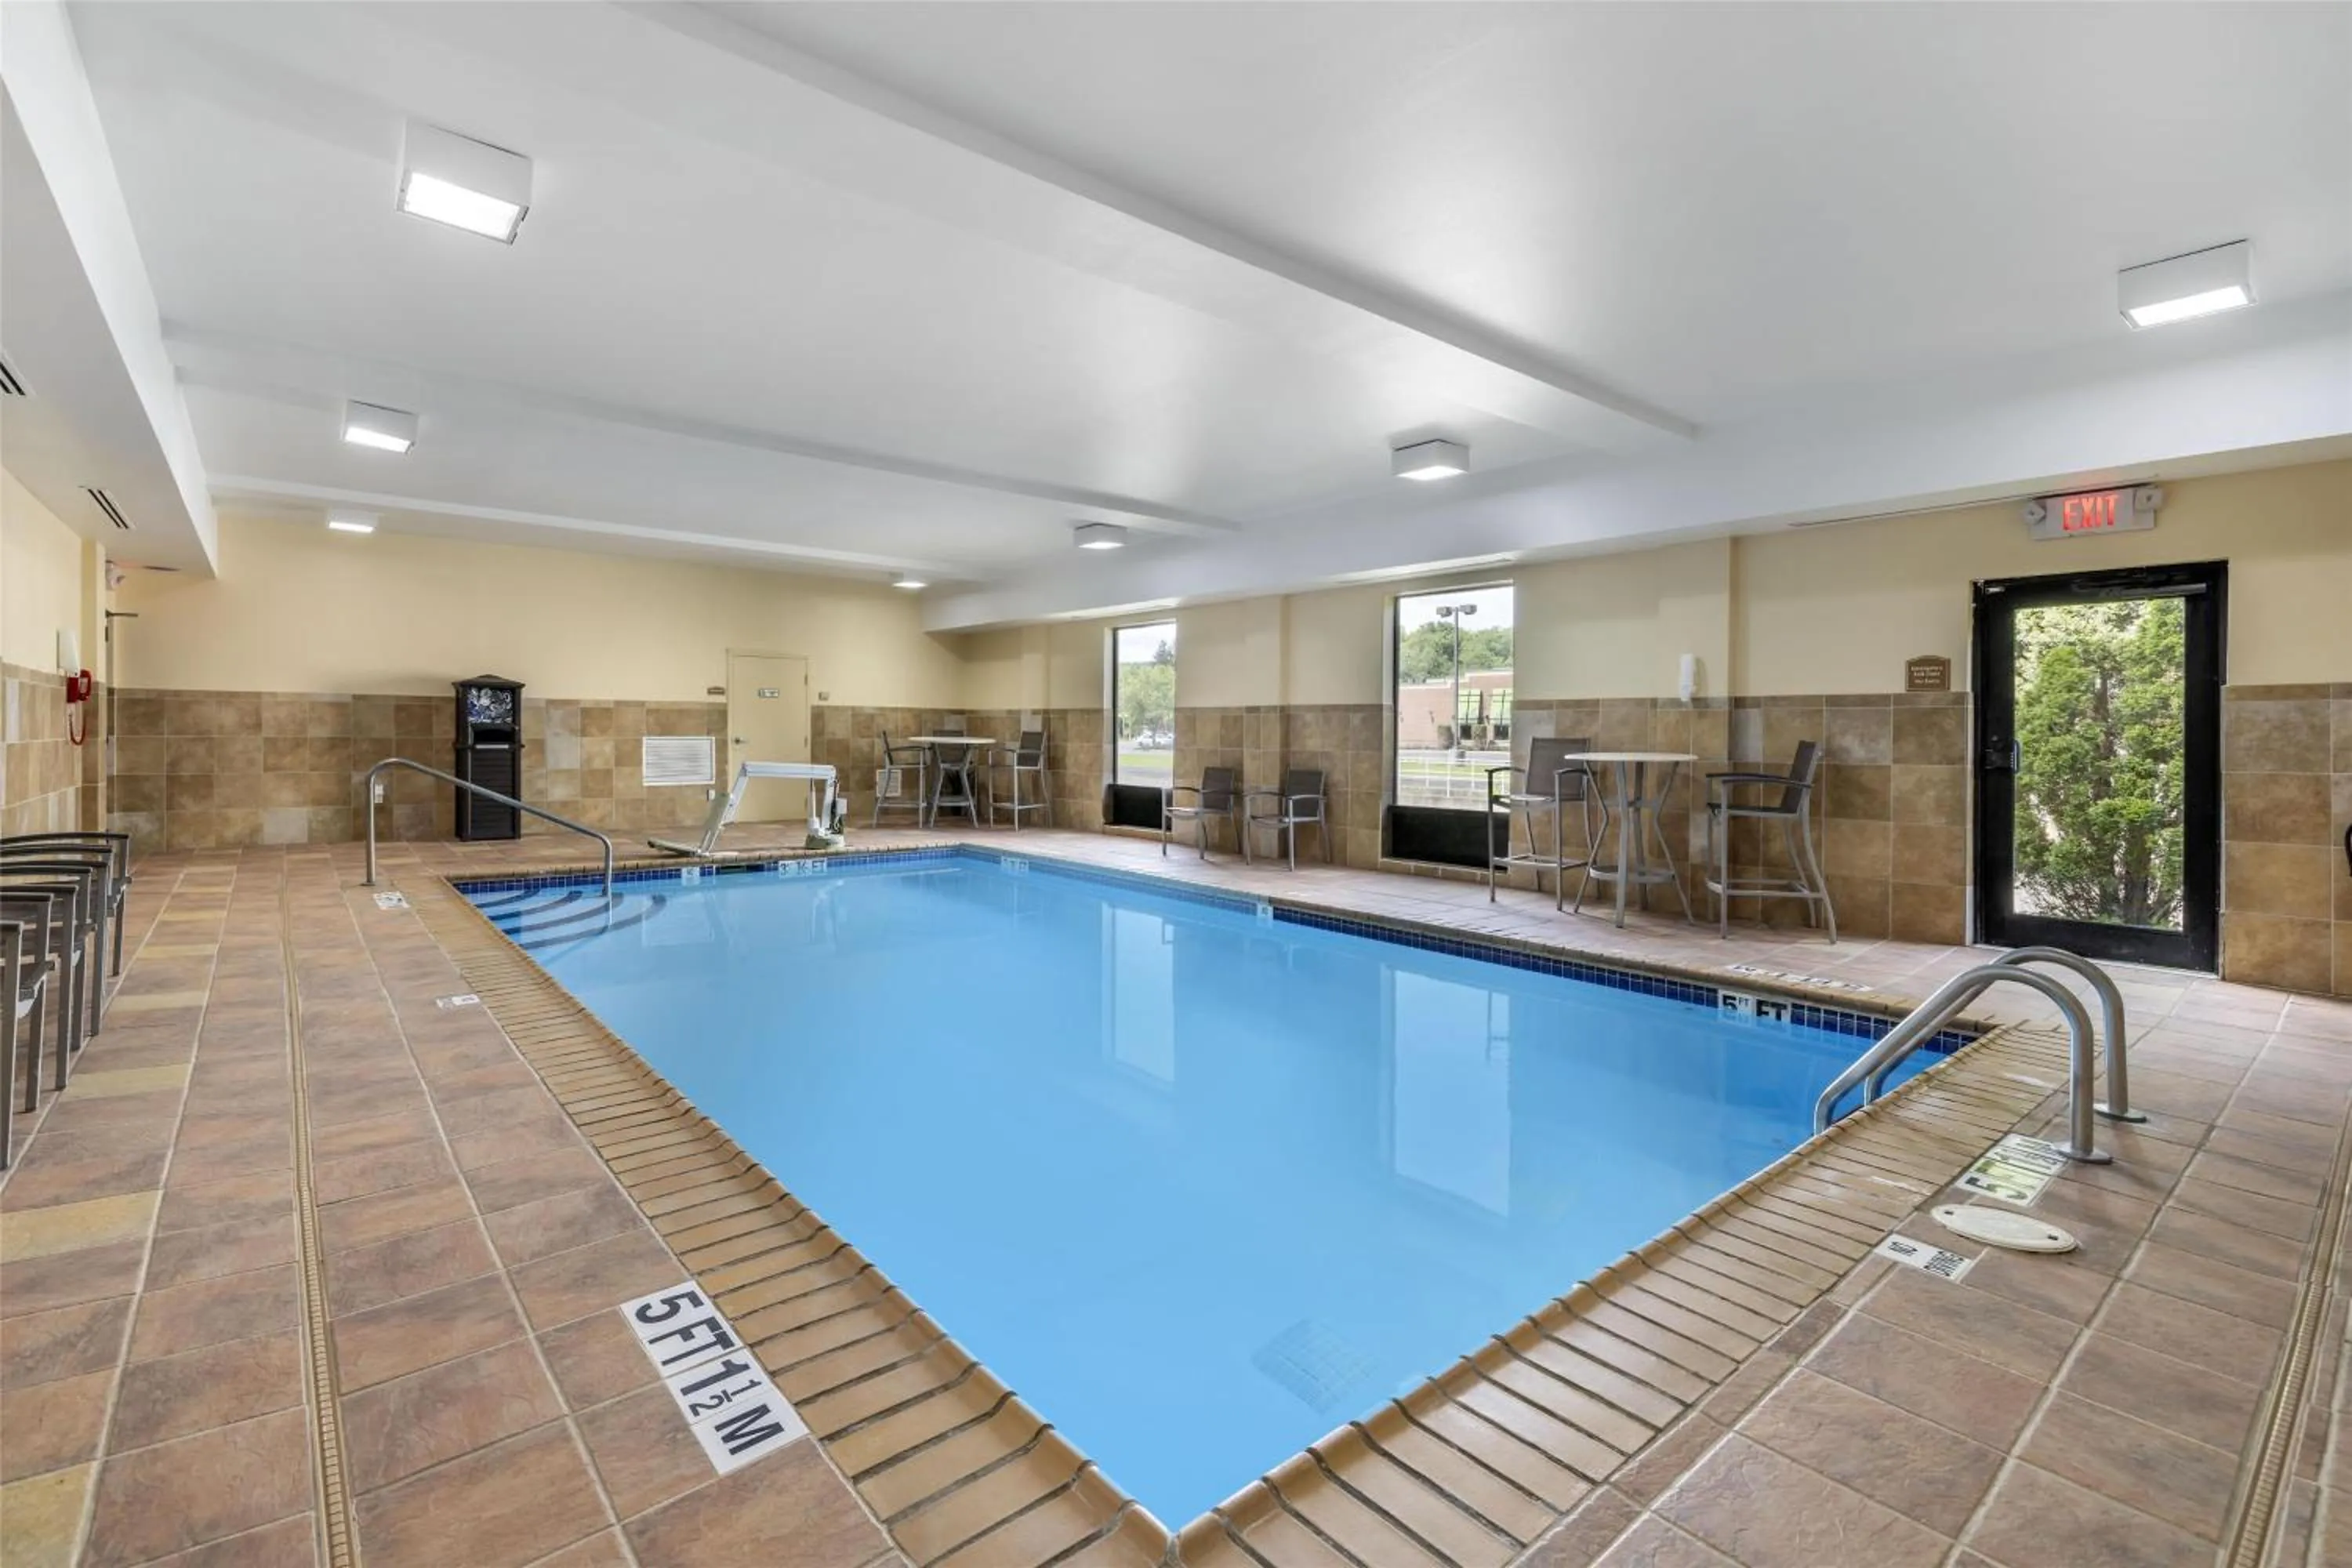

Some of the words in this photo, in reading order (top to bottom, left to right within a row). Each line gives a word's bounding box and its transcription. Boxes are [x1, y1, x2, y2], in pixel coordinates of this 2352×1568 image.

[2063, 494, 2120, 532] EXIT
[635, 1290, 704, 1324] 5
[648, 1316, 735, 1367] FT
[714, 1403, 785, 1456] M
